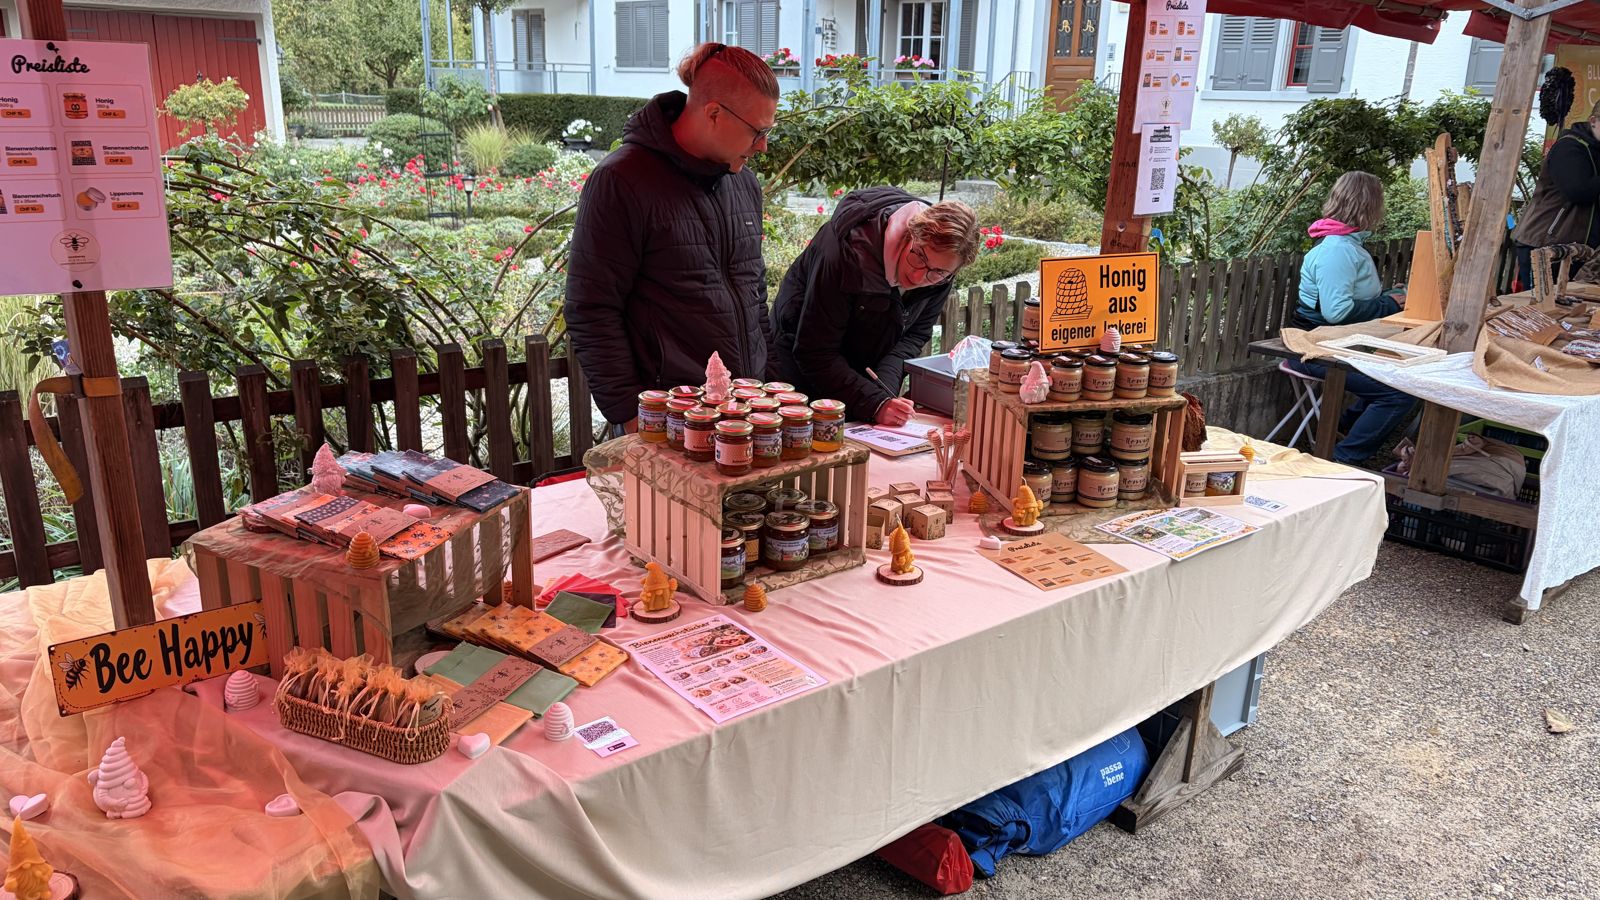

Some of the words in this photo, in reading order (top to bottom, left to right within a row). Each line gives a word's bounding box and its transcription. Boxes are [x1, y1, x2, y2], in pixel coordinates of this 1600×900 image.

[11, 54, 90, 74] Preisliste
[1100, 263, 1146, 292] Honig
[1108, 295, 1137, 314] aus
[1051, 324, 1096, 345] eigener
[89, 643, 153, 694] Bee
[158, 621, 254, 677] Happy
[1100, 762, 1123, 779] passa
